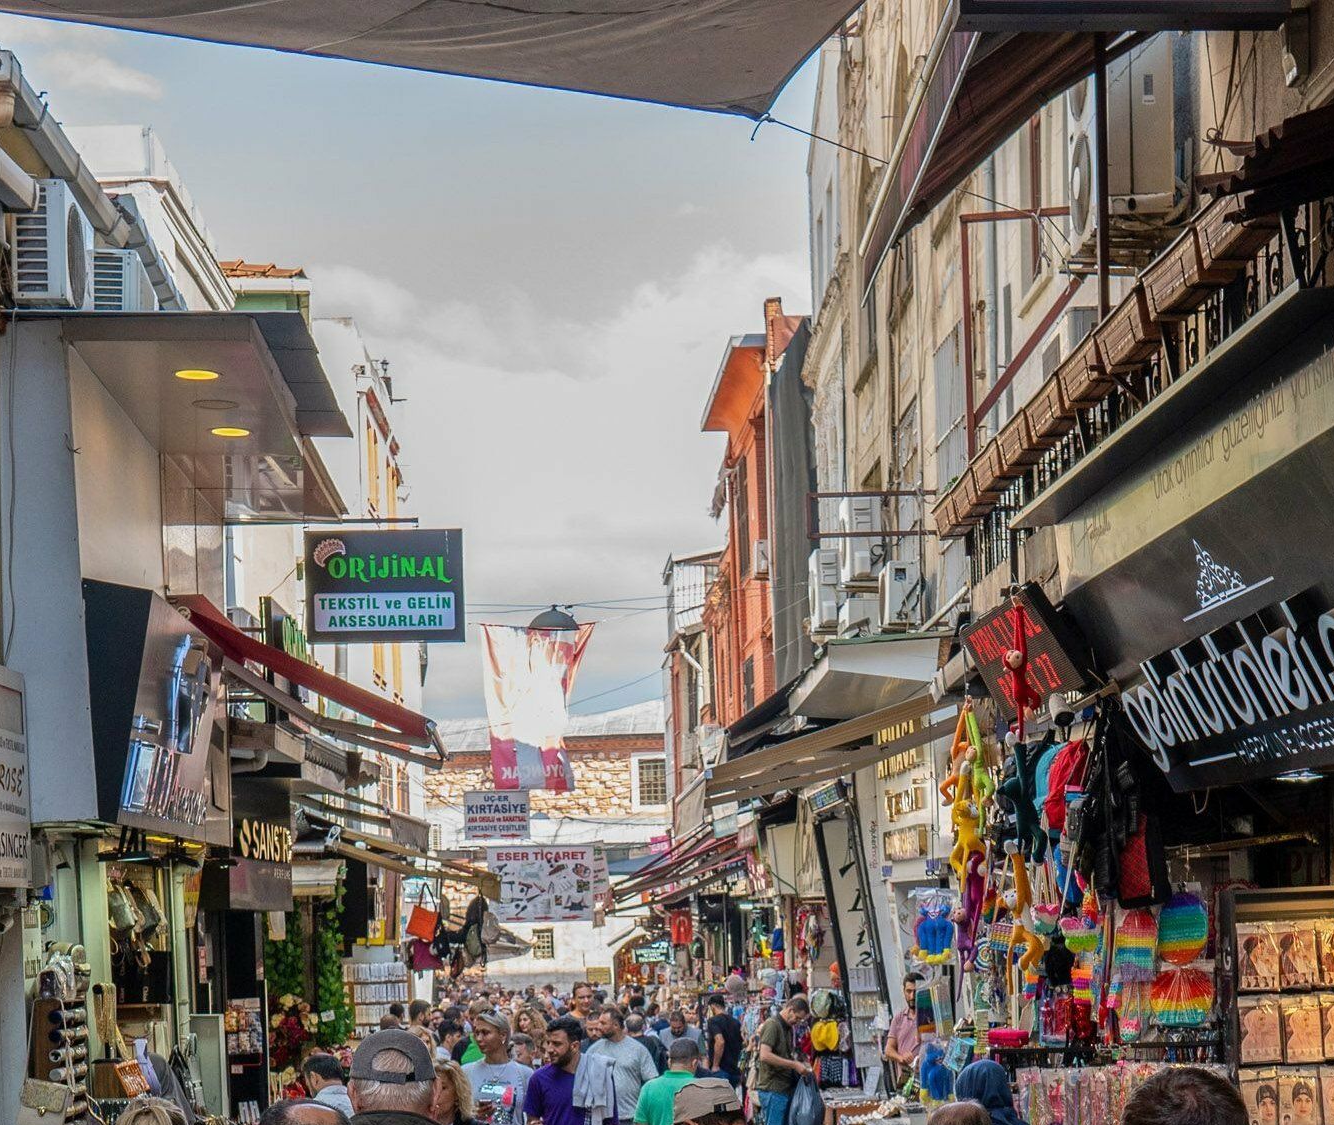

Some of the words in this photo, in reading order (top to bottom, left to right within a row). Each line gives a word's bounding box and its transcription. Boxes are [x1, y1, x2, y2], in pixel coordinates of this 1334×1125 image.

[327, 554, 453, 584] ORİJİNAL
[318, 594, 380, 611] TEKSTİL
[385, 599, 402, 610] ve
[407, 593, 451, 609] GELİN
[328, 614, 443, 628] AKSESUARLARI
[1234, 736, 1269, 766] HAPPY
[467, 802, 527, 815] KIRTASİYE
[496, 851, 529, 862] ESER
